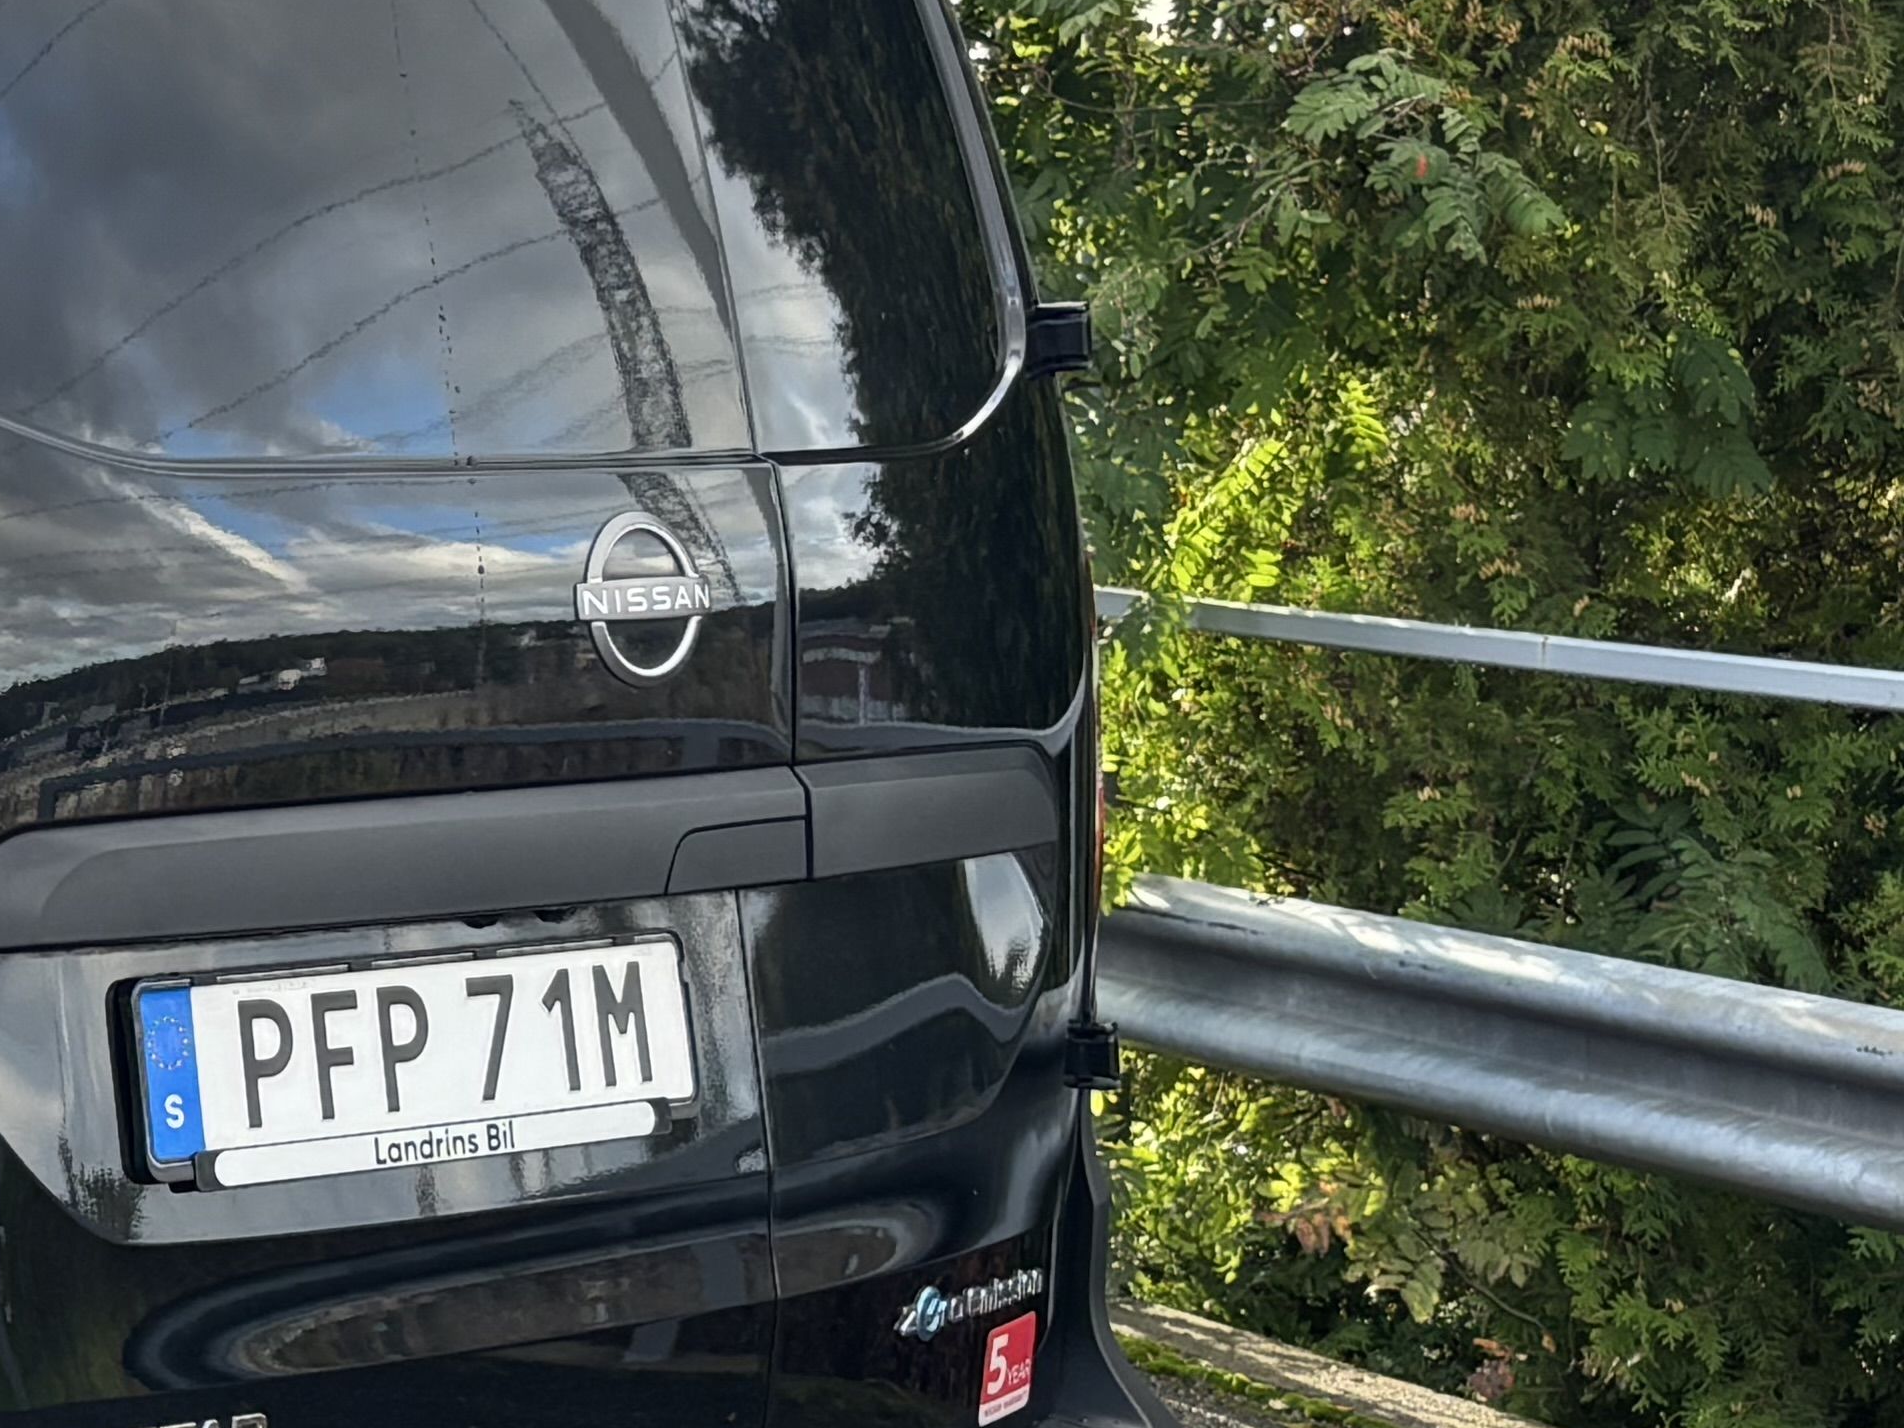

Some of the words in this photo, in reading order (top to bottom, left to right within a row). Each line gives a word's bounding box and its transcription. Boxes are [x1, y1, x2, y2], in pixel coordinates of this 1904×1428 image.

[582, 583, 711, 616] NISSAN
[164, 1093, 185, 1129] S
[235, 985, 430, 1130] PFP
[465, 960, 654, 1102] 71M
[374, 1127, 480, 1165] Landrins
[486, 1119, 516, 1151] Bil
[986, 1333, 1010, 1396] 5
